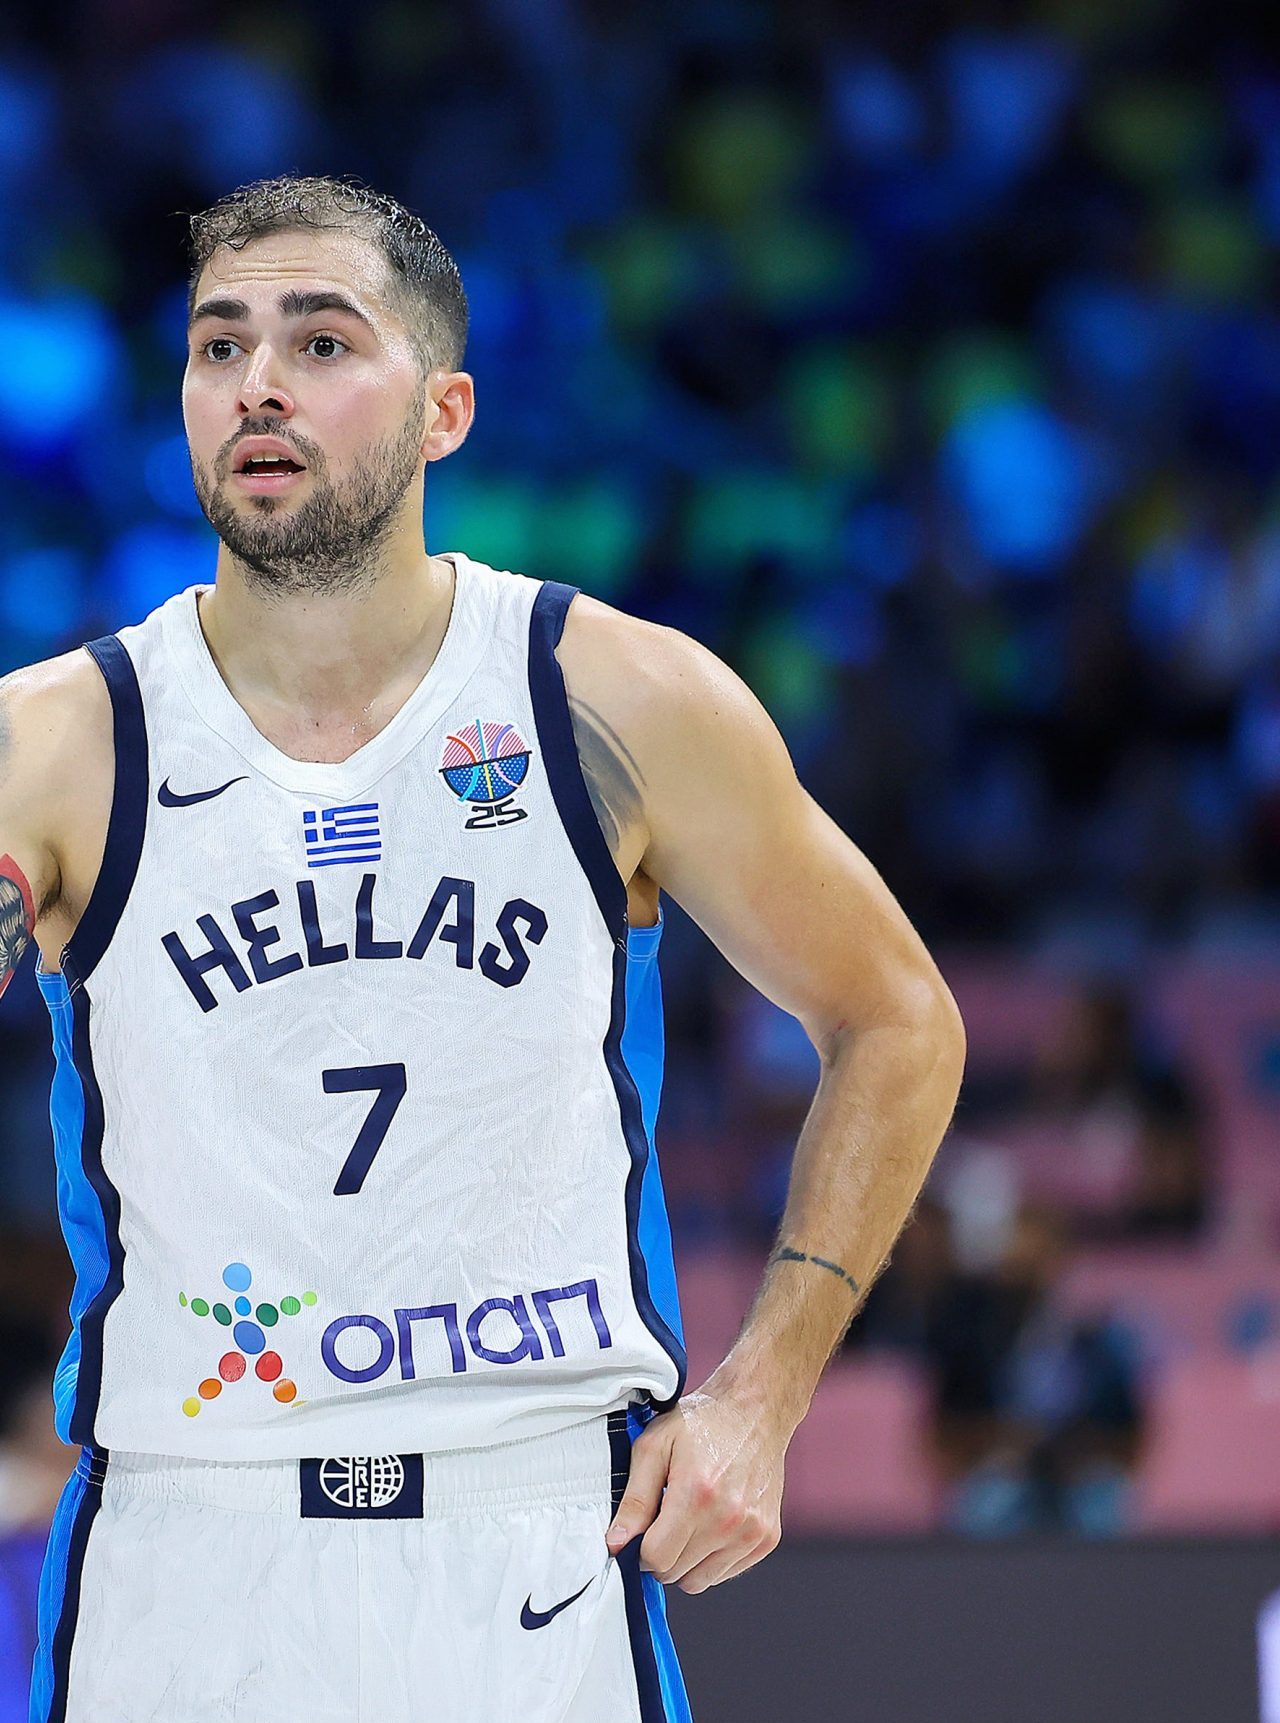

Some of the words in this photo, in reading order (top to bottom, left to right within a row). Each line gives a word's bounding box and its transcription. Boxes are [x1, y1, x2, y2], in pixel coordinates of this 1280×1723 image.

[464, 798, 529, 830] 25
[160, 873, 549, 1014] HELLAS
[321, 1062, 408, 1196] 7
